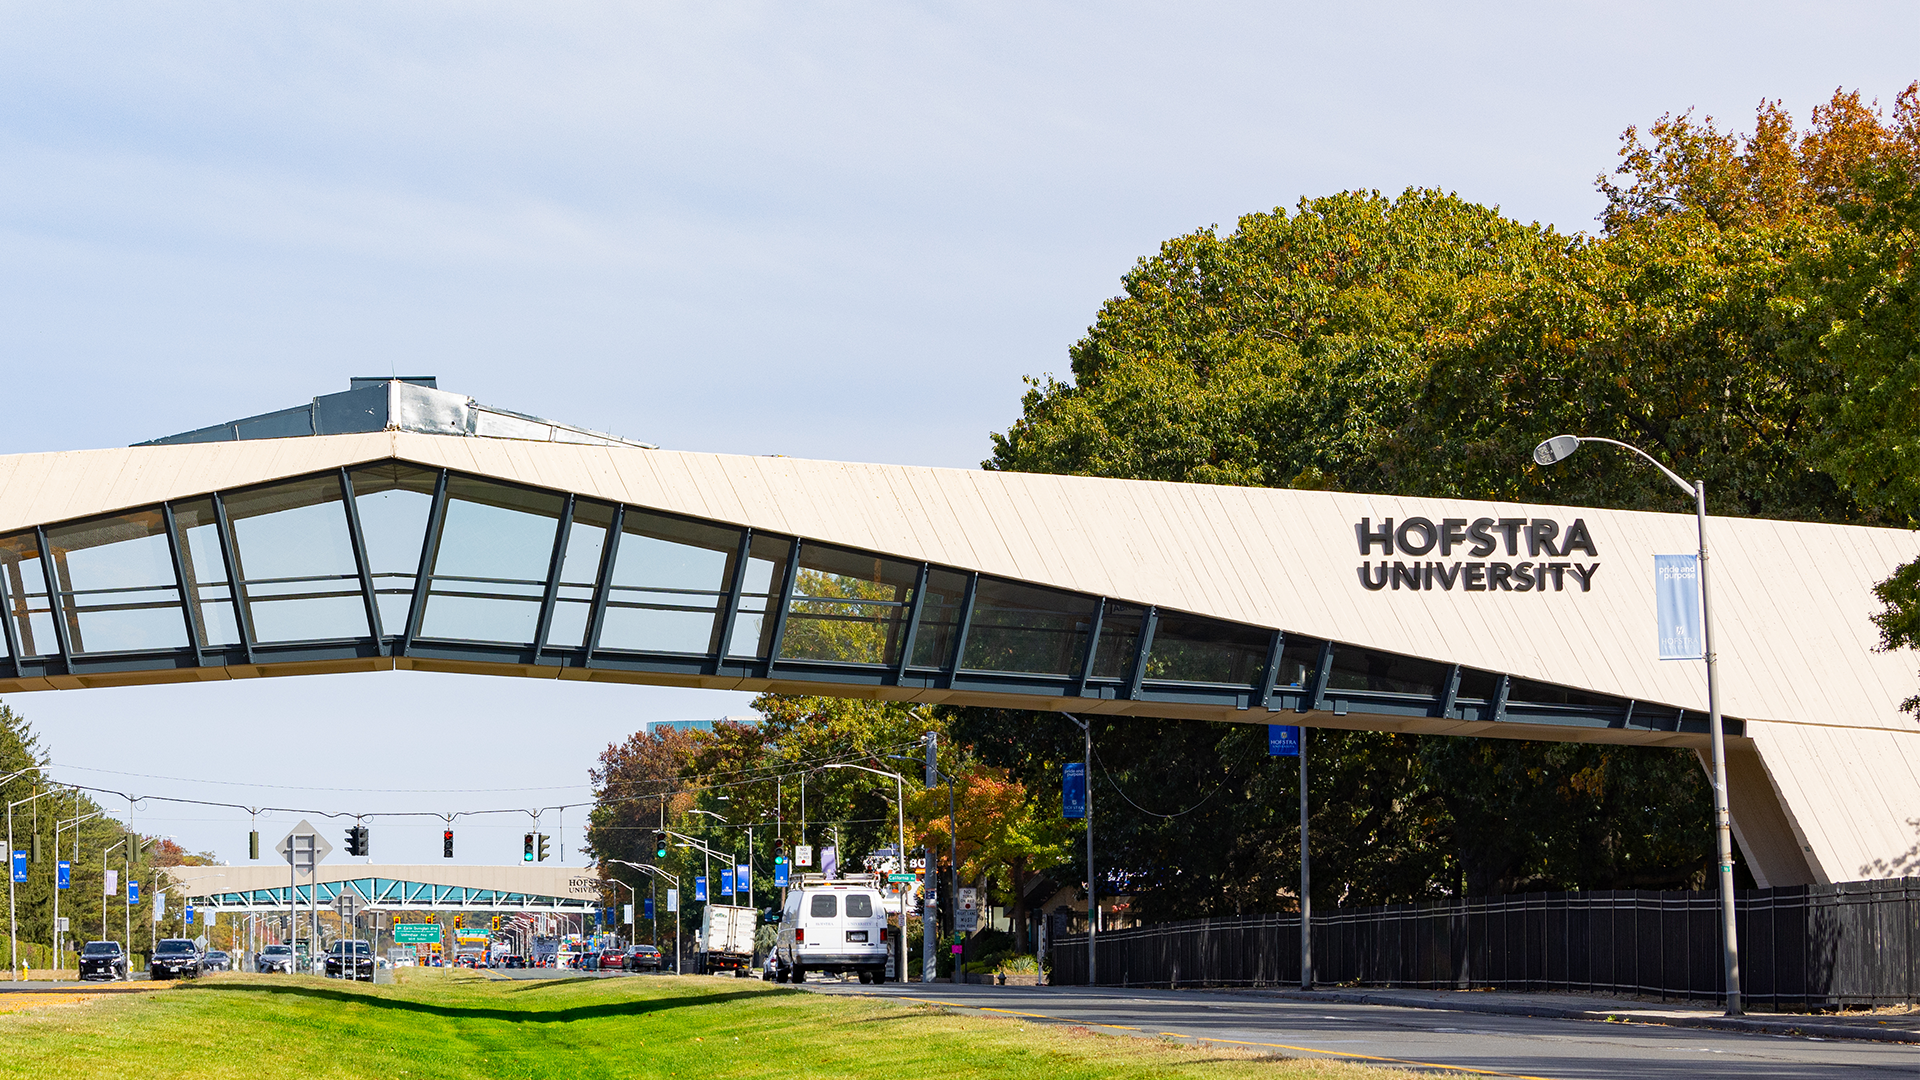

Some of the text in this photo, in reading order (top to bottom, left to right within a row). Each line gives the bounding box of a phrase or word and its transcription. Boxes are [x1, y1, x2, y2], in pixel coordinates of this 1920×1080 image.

[1356, 517, 1598, 557] HOFSTRA
[1658, 565, 1695, 575] pride and
[1358, 561, 1600, 592] UNIVERSITY
[1664, 572, 1695, 580] purpose
[1661, 637, 1699, 645] HOFSTRA
